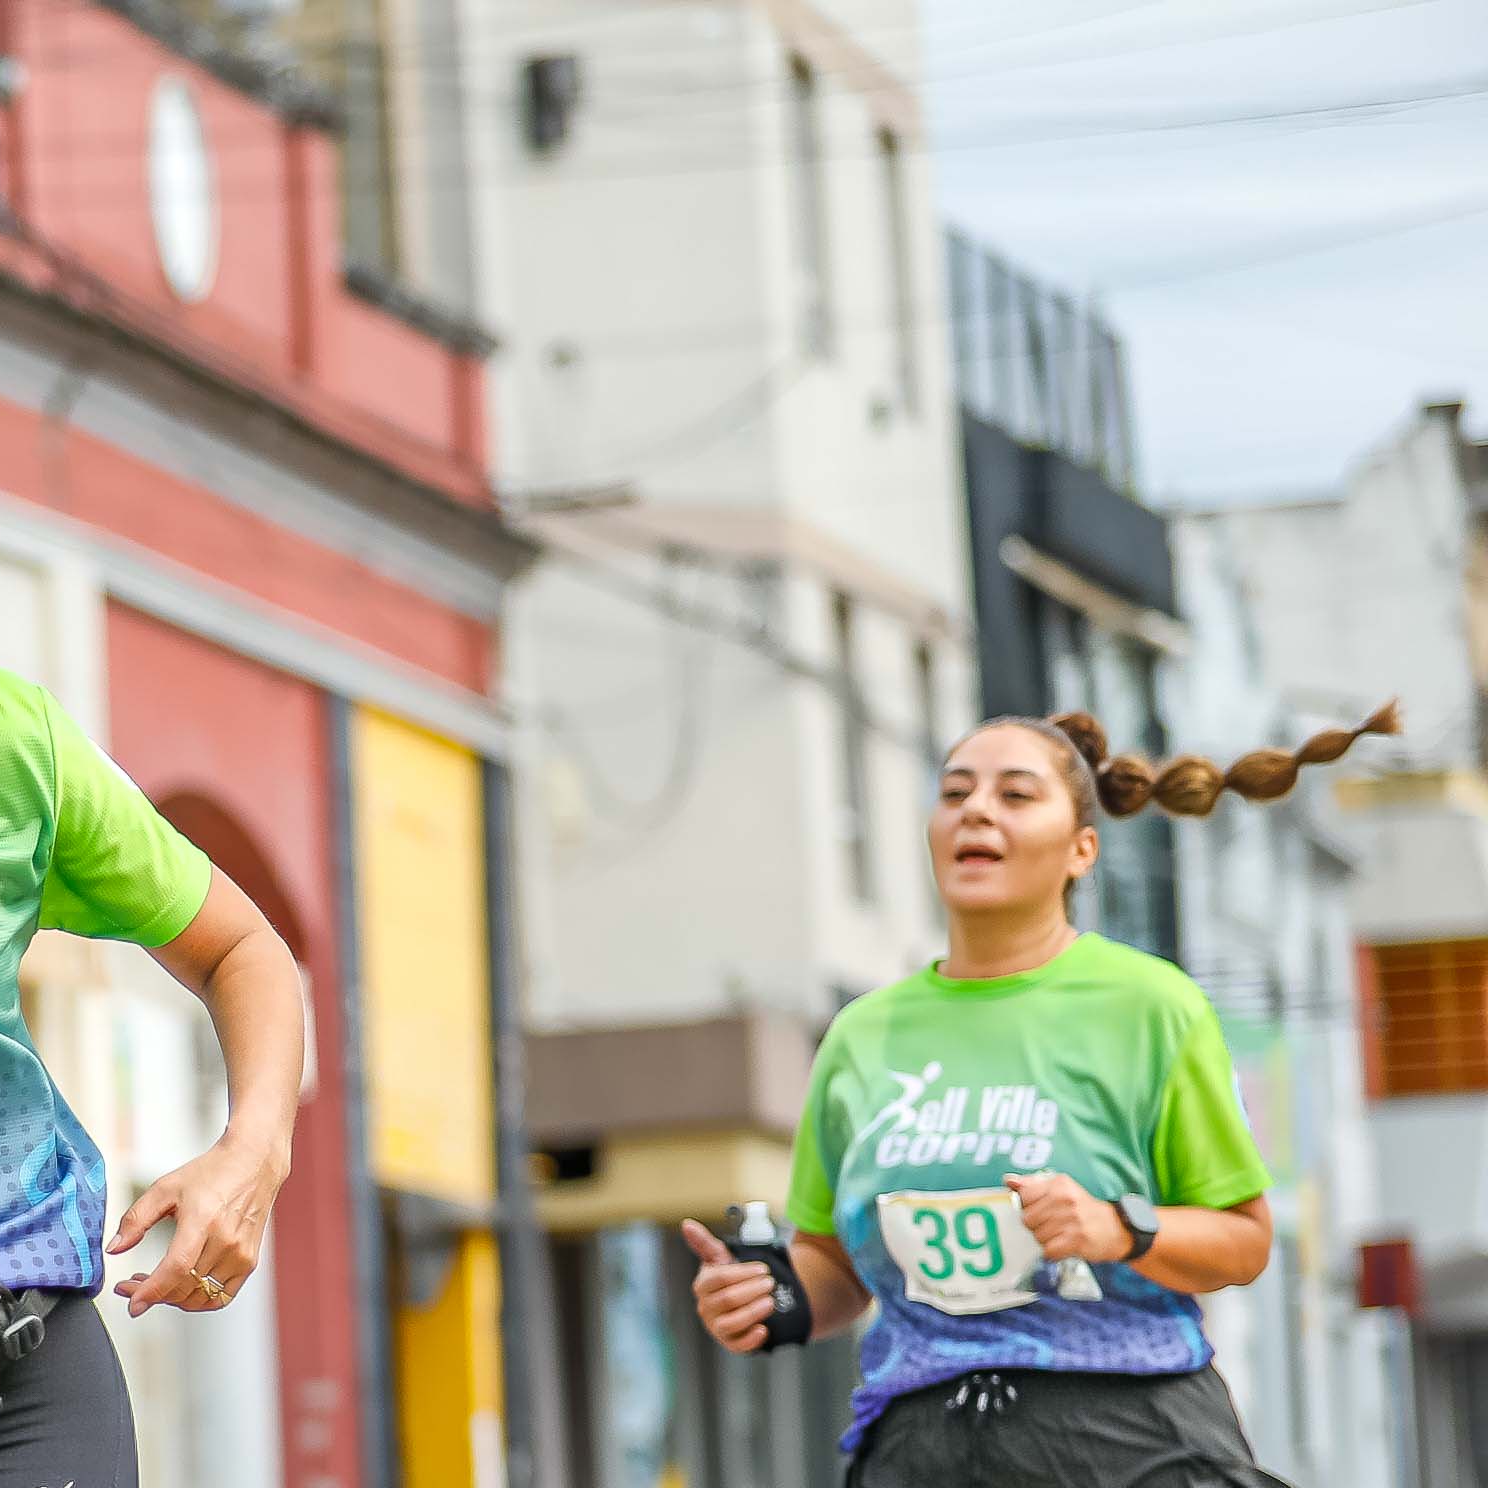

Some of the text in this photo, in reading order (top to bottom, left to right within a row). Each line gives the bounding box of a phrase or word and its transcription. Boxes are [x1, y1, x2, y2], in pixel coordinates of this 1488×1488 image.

[978, 1085, 1058, 1135] Ville
[875, 1131, 1052, 1169] corre
[913, 1206, 1004, 1280] 39
